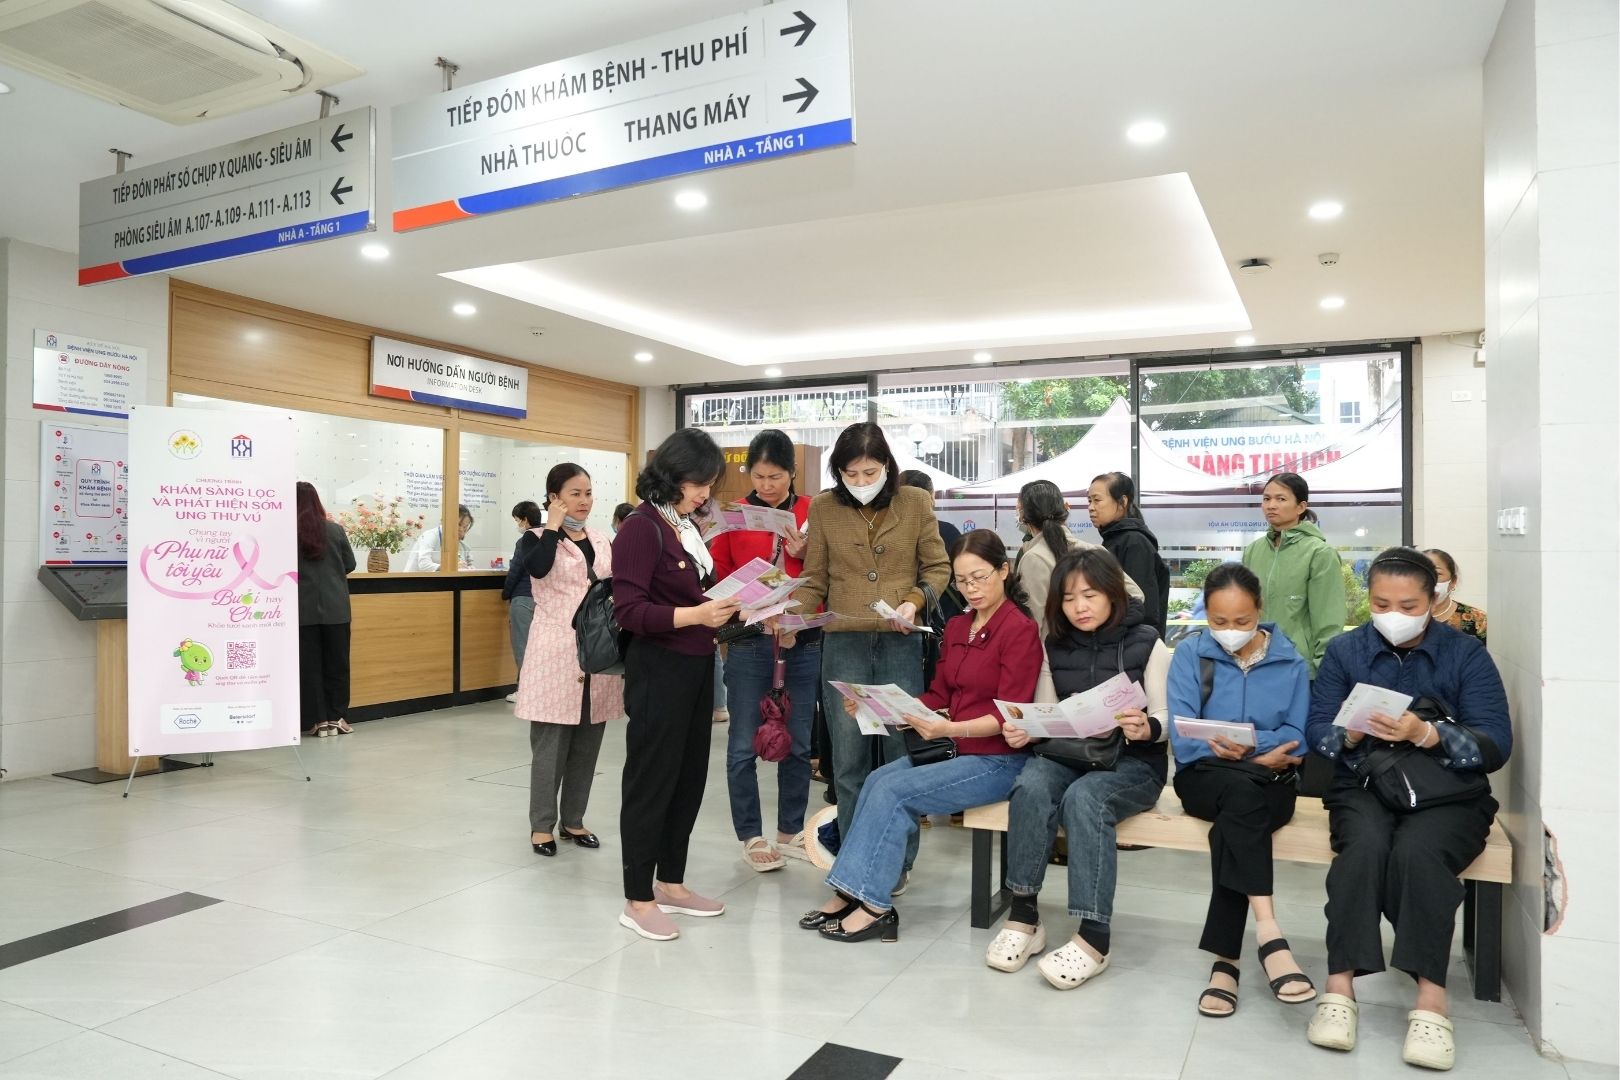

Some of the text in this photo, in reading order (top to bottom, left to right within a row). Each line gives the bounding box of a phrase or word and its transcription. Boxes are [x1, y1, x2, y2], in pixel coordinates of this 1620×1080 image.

[447, 96, 483, 128] TIẾP
[486, 86, 527, 118] ĐÓN
[531, 72, 587, 107] KHÁM
[592, 61, 646, 94] BỆNH
[661, 42, 705, 72] THU
[711, 26, 749, 62] PHÍ
[624, 93, 752, 143] THANG MÁY
[704, 141, 734, 165] NHÀ
[736, 143, 746, 158] A
[798, 134, 804, 149] 1
[480, 147, 519, 176] NHÀ
[112, 181, 131, 205] TIẾP
[132, 177, 151, 201] ĐÓN
[153, 173, 177, 196] PHÁT
[191, 163, 217, 187] CHỤP
[218, 161, 226, 179] X
[227, 151, 263, 178] QUANG
[270, 142, 294, 166] SIÊU
[294, 138, 312, 161] ÂM
[114, 225, 145, 249] PHÒNG
[146, 219, 167, 242] SIÊU
[167, 216, 183, 239] ÂM
[215, 208, 241, 228] A.109
[248, 199, 275, 221] A.111
[282, 190, 311, 213] A.113
[278, 228, 297, 243] NHÀ
[298, 228, 304, 239] A
[335, 222, 340, 233] 1
[99, 361, 112, 369] DÂY
[112, 363, 130, 372] NÓNG
[387, 353, 520, 391] NƠI HƯỚNG DẪN NGƯỜI BỆNH
[468, 385, 482, 395] DESK
[1193, 436, 1217, 449] VIỆN
[1220, 436, 1246, 447] UNG
[160, 484, 276, 500] KHÁM SÀNG LỌC
[152, 495, 282, 512] VÀ PHÁT HIỆN SỚM
[176, 511, 262, 522] UNG THƯ VÚ
[188, 528, 232, 537] Chung tay
[204, 537, 231, 545] người
[154, 540, 229, 564] Phụ nữ
[166, 562, 223, 586] tôi yêu
[266, 596, 283, 604] hay
[229, 605, 281, 623] Chanh
